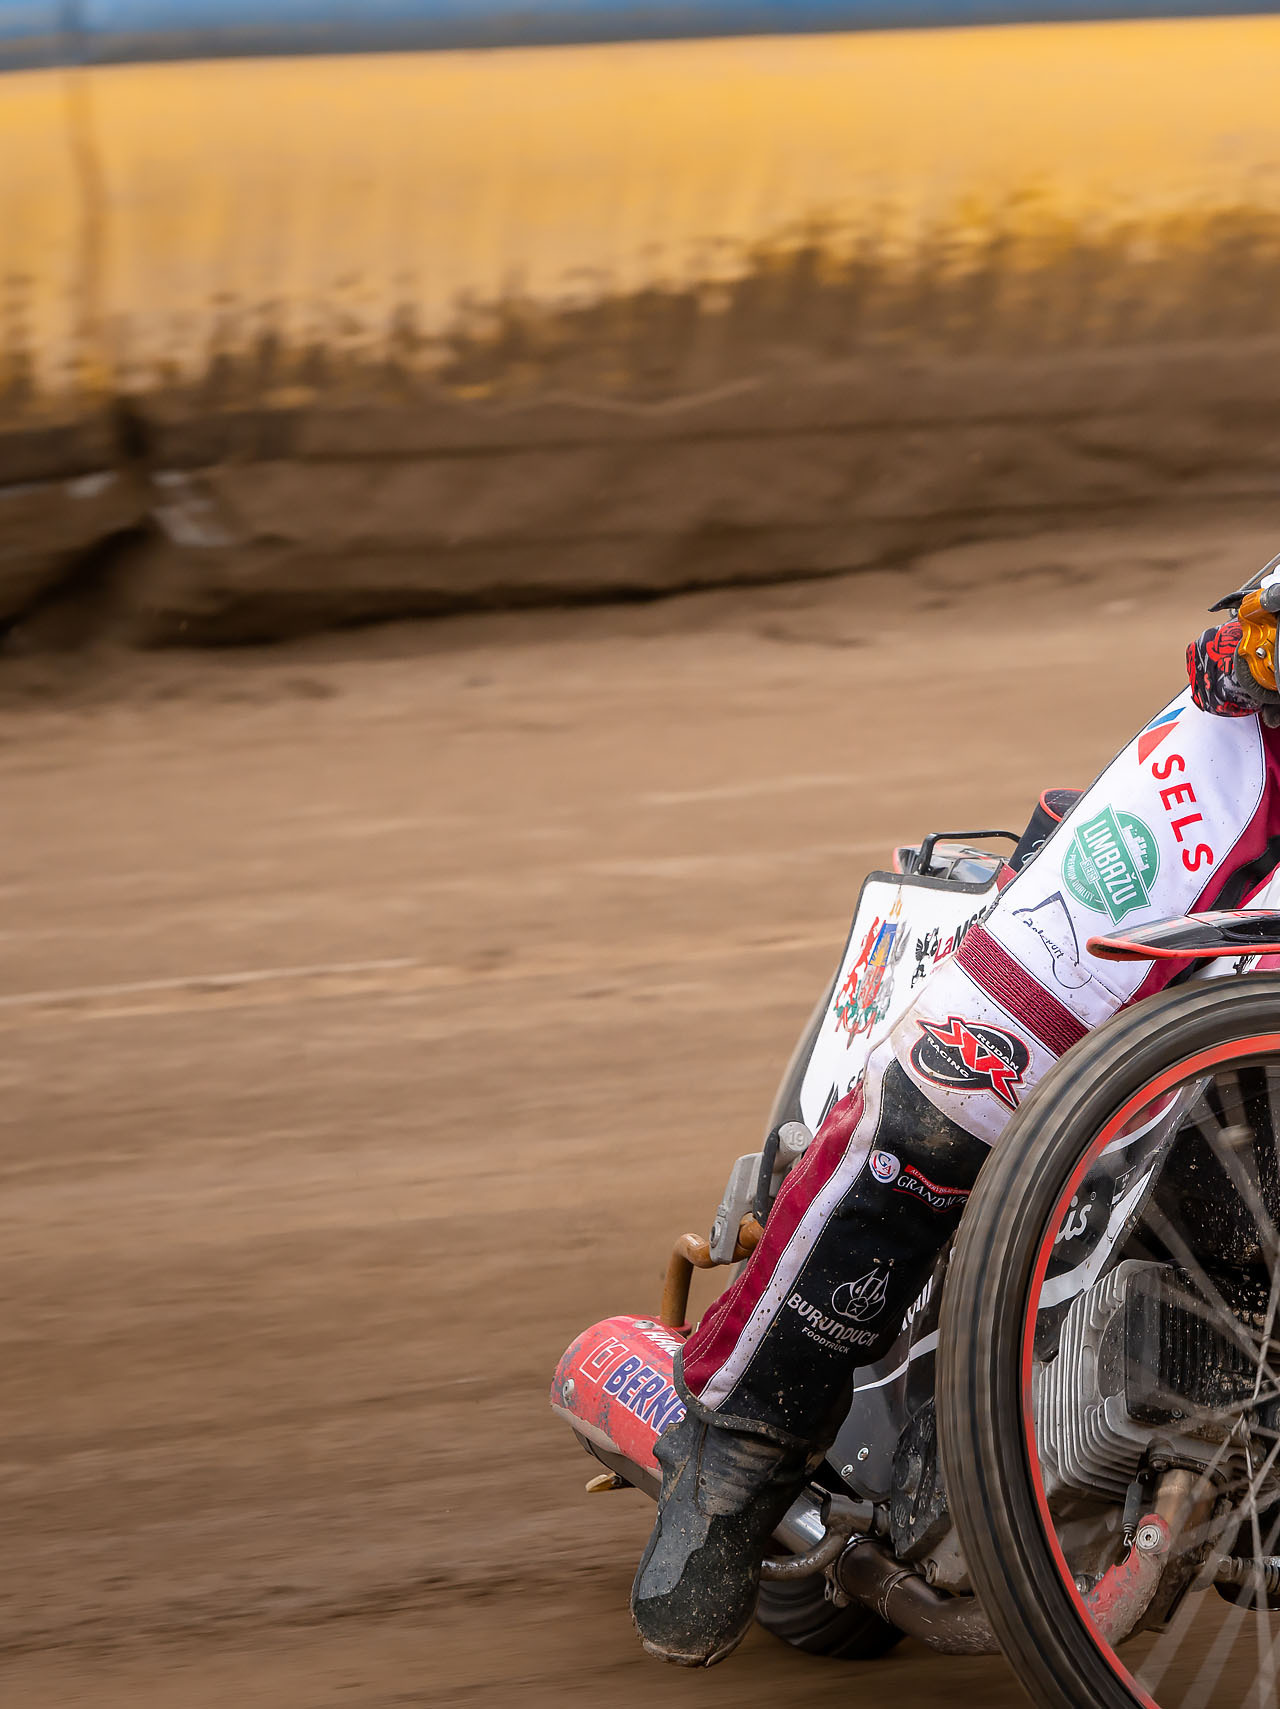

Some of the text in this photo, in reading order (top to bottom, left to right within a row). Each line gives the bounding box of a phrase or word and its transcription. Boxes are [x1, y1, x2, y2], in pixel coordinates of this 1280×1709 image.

[1152, 754, 1213, 872] SELS
[1083, 820, 1137, 905] LIMBAŽU
[1072, 880, 1095, 902] QUALITY
[927, 1036, 969, 1078] RACING
[977, 1033, 1019, 1070] RUDAN
[897, 1175, 945, 1208] GRAND
[802, 1326, 849, 1354] FOODTRUCK
[602, 1355, 687, 1436] BERNE
